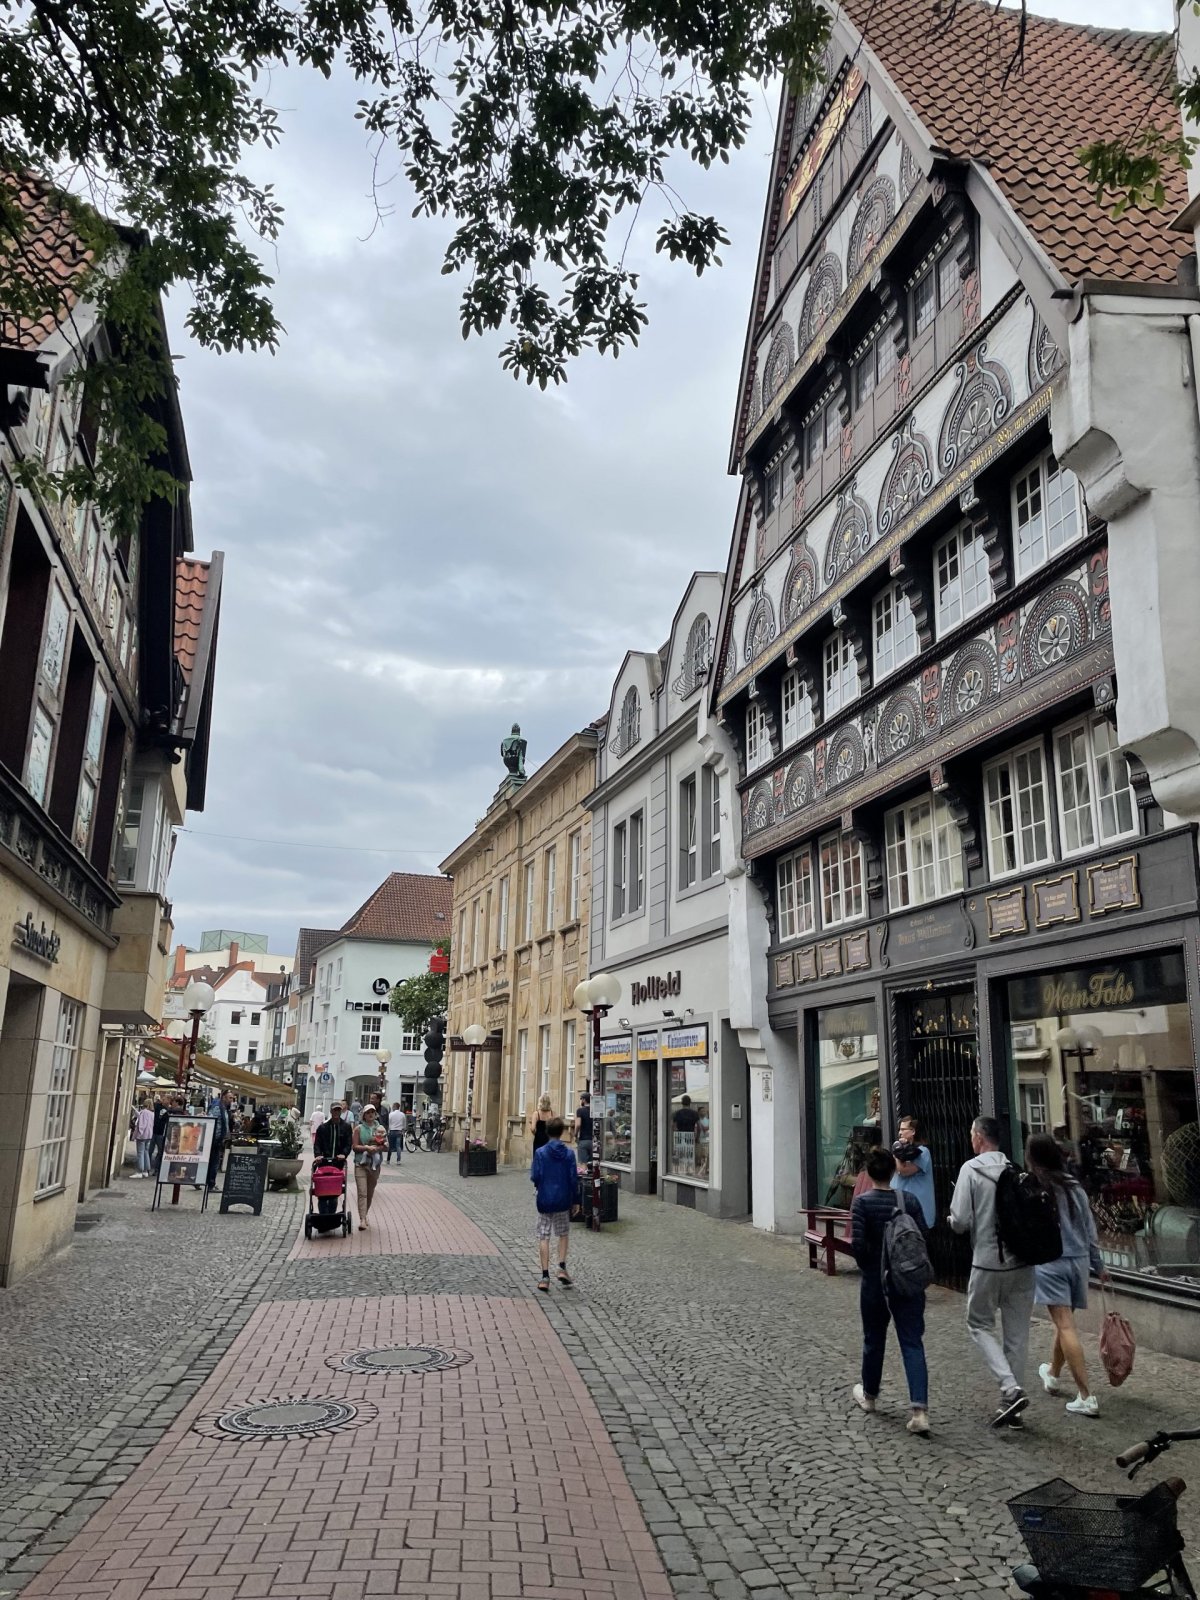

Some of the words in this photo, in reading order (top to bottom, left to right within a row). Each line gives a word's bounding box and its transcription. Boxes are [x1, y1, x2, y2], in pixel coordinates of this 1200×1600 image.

[631, 971, 681, 1005] Hollfeld
[1043, 981, 1089, 1016] Wein
[1089, 968, 1135, 1008] Fohs
